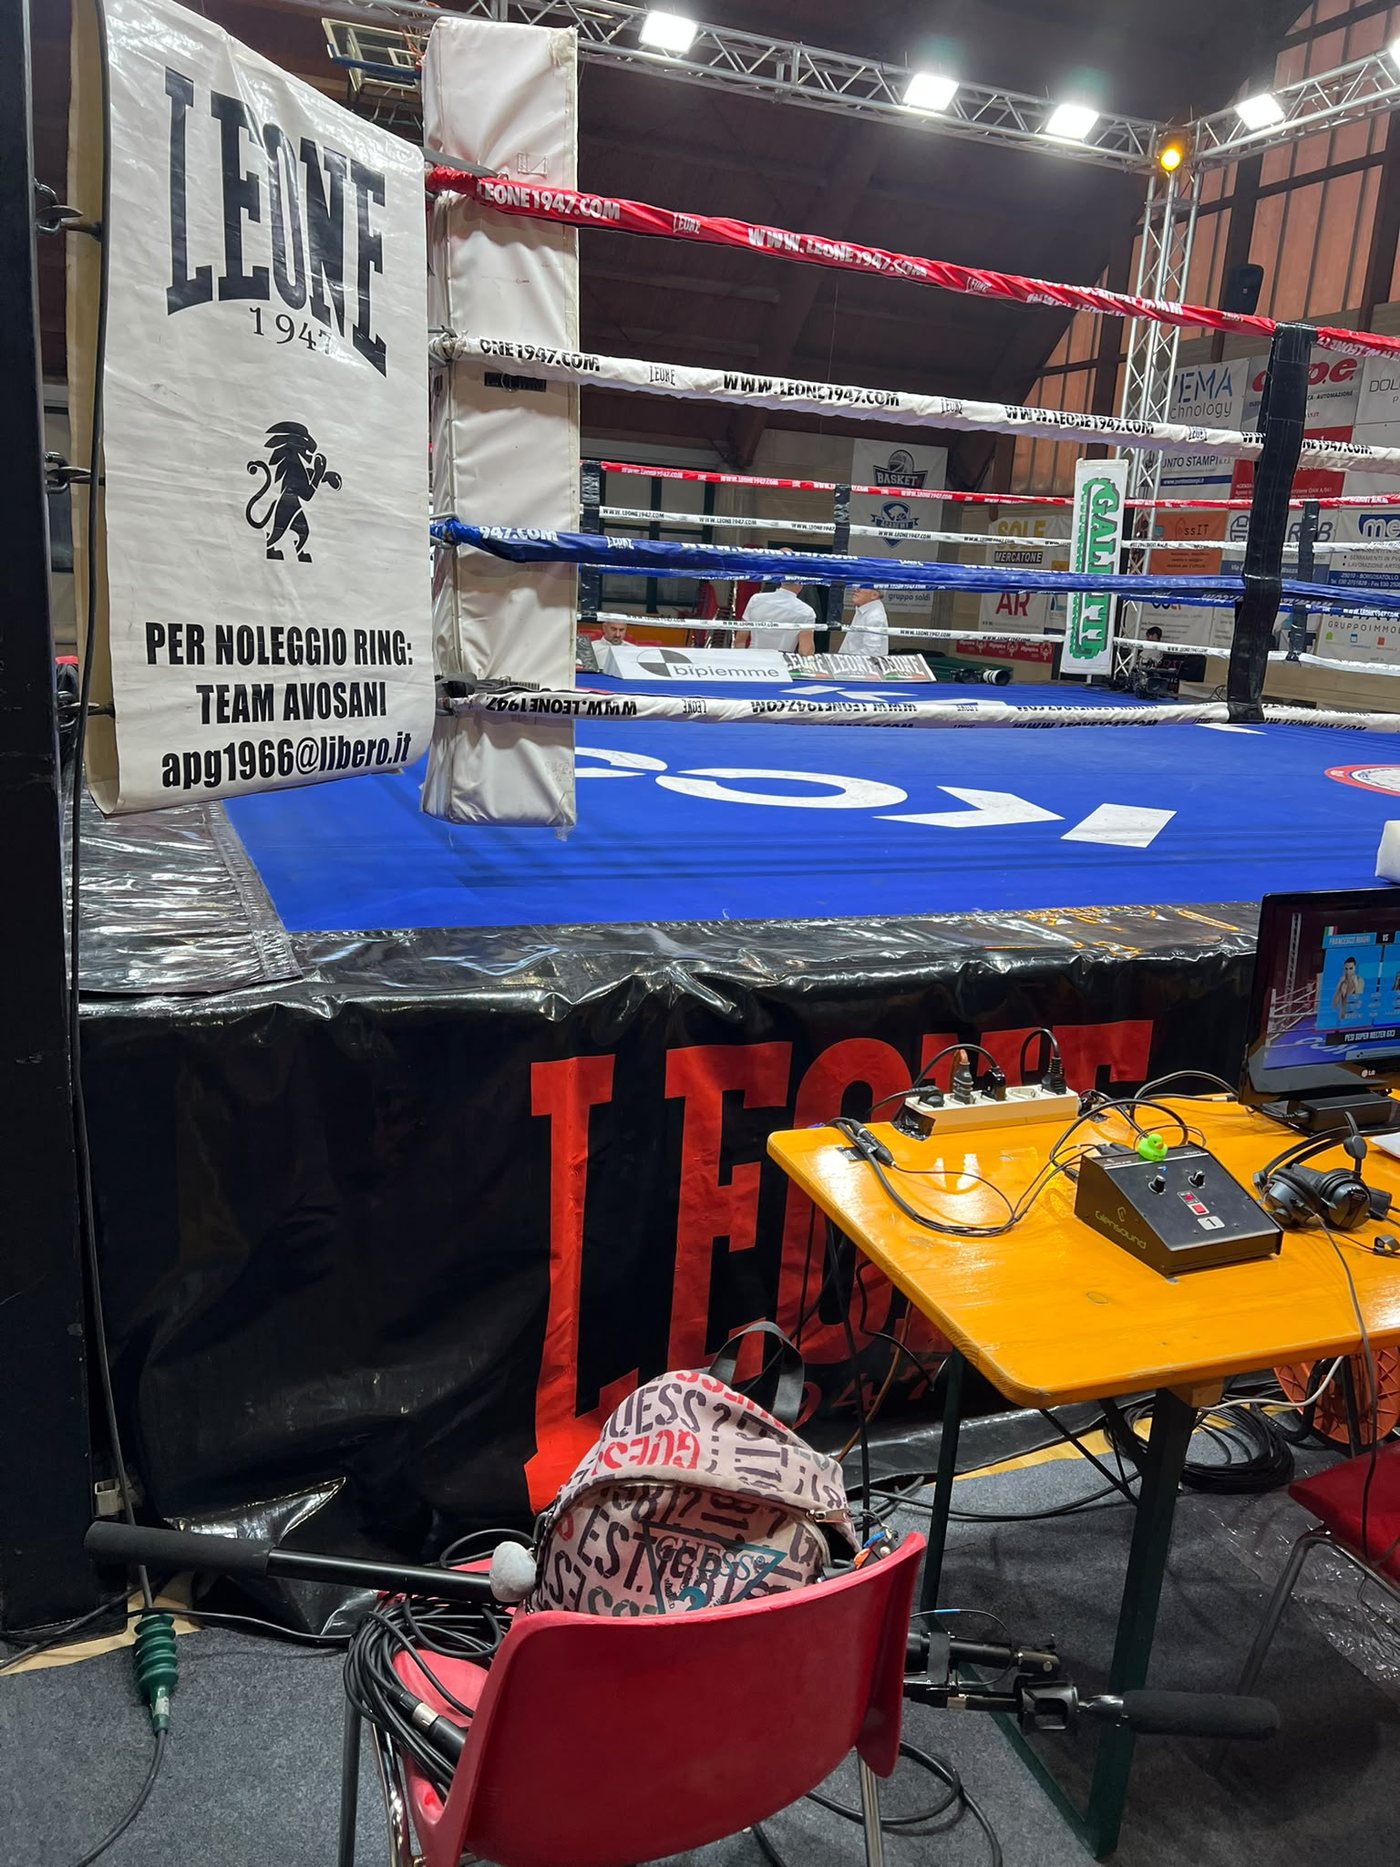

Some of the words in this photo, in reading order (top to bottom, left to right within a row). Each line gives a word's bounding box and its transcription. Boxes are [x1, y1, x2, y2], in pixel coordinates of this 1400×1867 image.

[165, 66, 387, 377] LEONE
[1186, 455, 1219, 467] STAMPI
[876, 472, 918, 487] BASKET
[995, 552, 1043, 564] MERCATONE
[888, 592, 914, 604] gruppo
[145, 622, 205, 666] PER
[215, 624, 346, 666] NOLEGGIO
[354, 629, 413, 666] RING:
[675, 664, 780, 679] bipiemme
[196, 683, 274, 724] TEAM
[283, 681, 387, 721] AVOSANI
[162, 731, 412, 790] apg1966@libero.it
